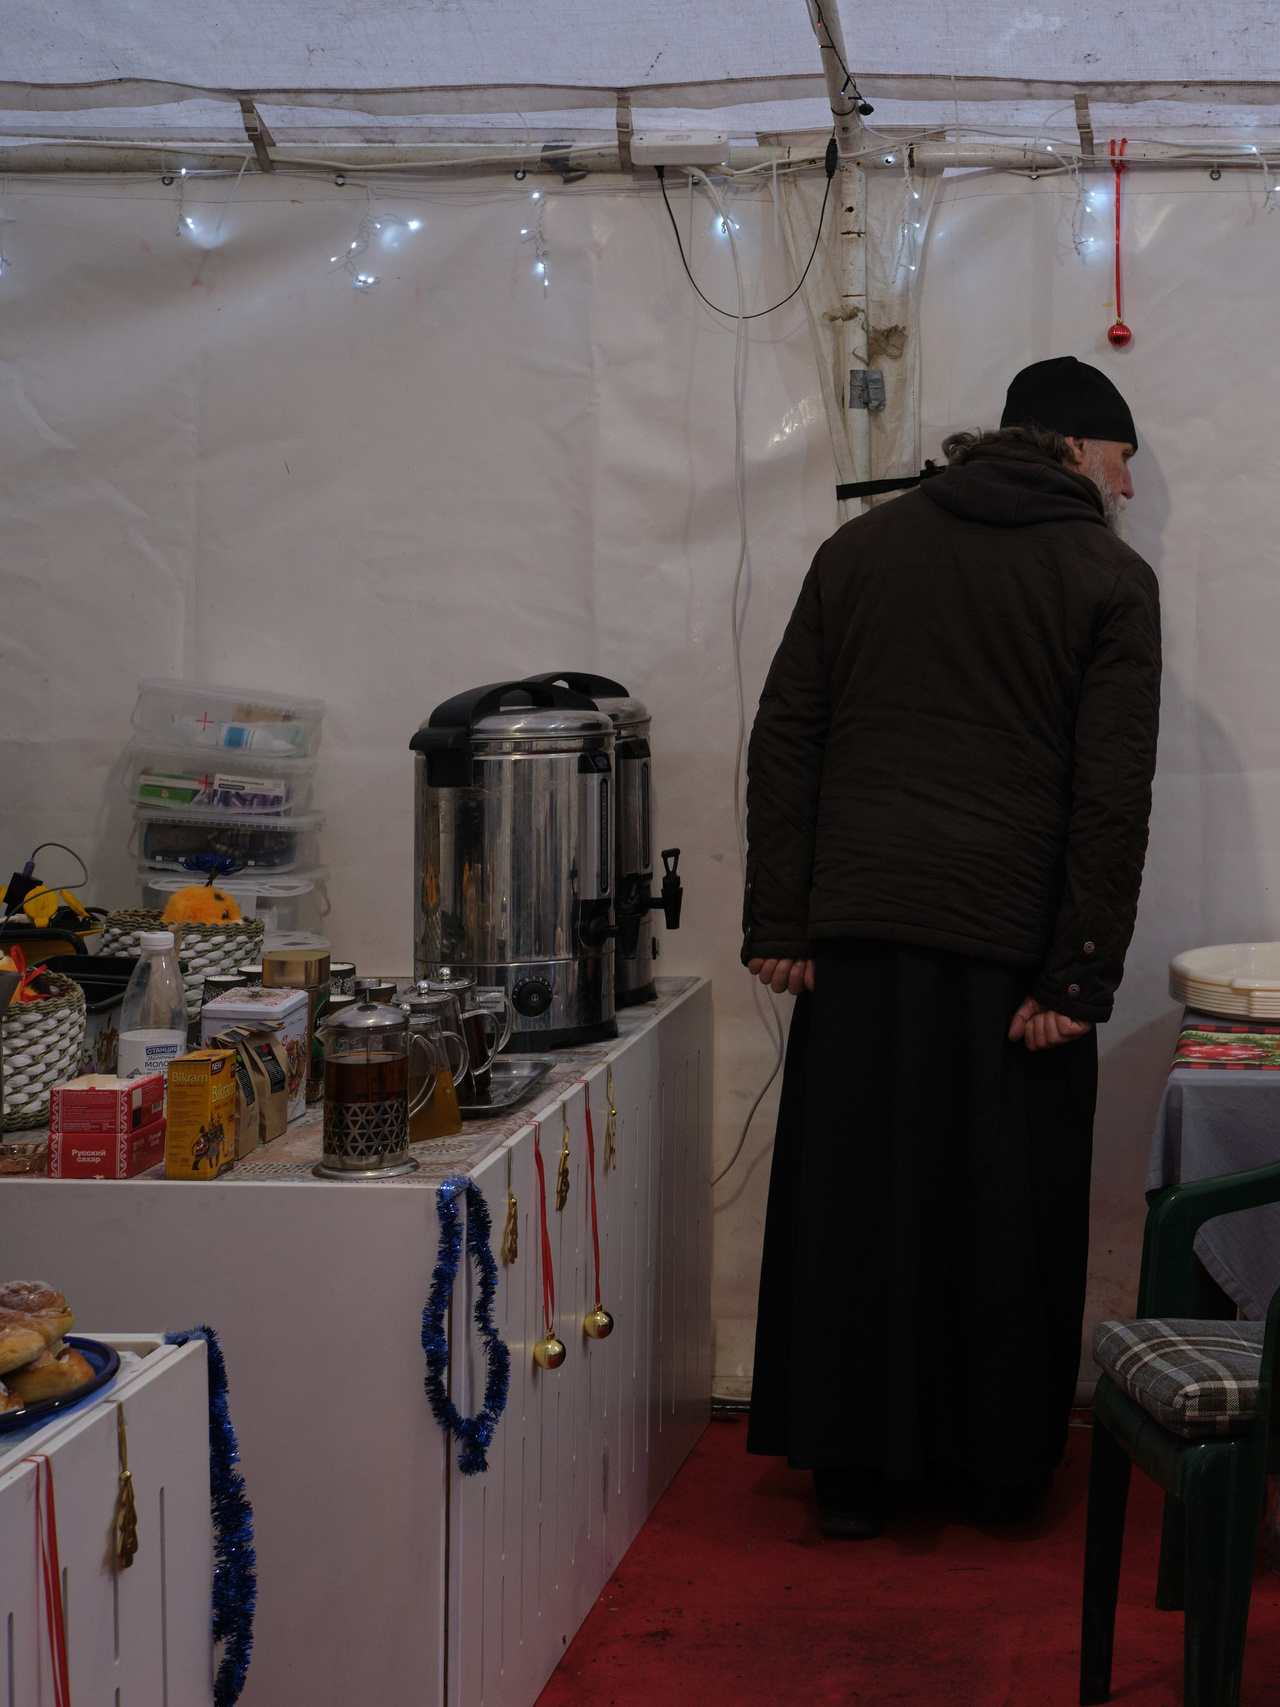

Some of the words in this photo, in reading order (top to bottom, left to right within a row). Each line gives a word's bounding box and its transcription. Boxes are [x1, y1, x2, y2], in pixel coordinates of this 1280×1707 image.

[144, 1060, 169, 1068] МОЛО
[212, 1060, 223, 1071] NEW
[171, 1071, 208, 1082] Bikram
[211, 1082, 236, 1104] Bikram
[71, 1148, 107, 1158] Русский
